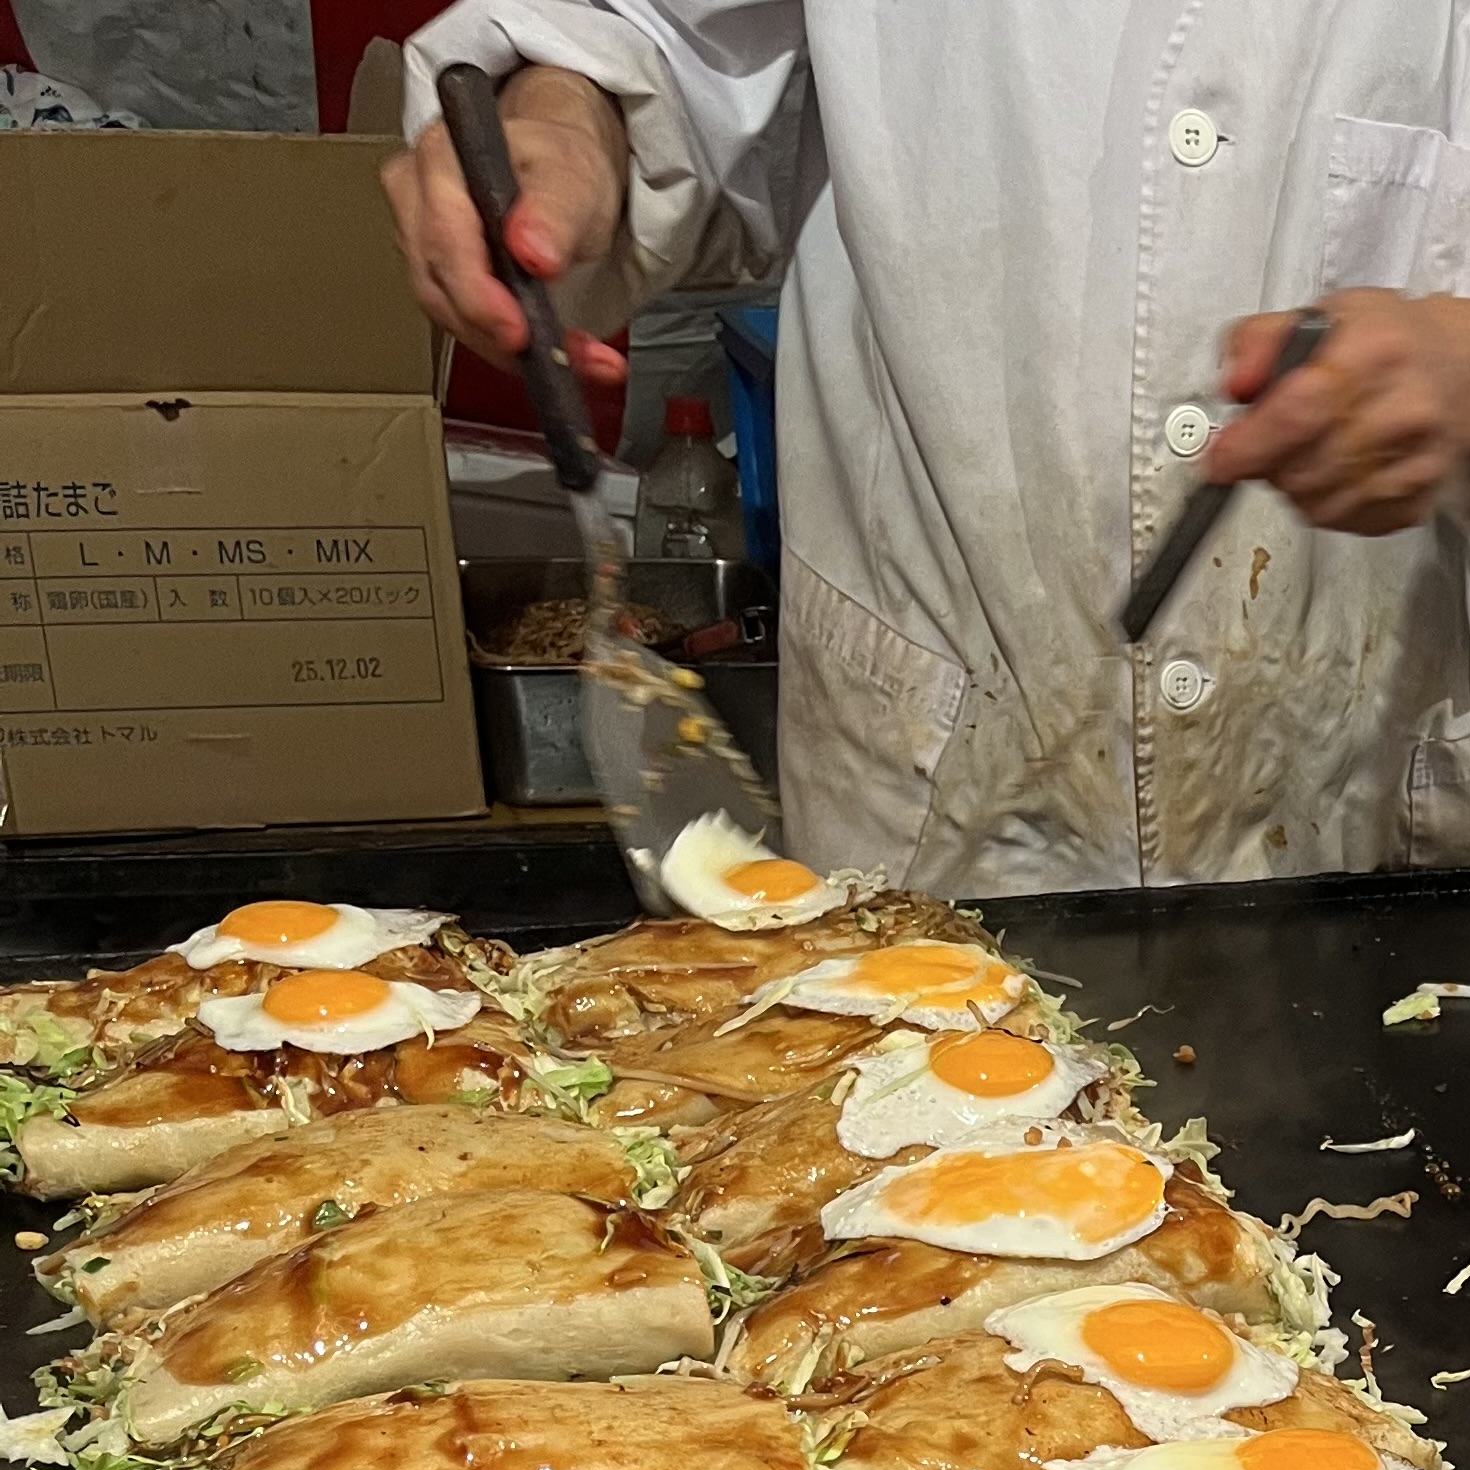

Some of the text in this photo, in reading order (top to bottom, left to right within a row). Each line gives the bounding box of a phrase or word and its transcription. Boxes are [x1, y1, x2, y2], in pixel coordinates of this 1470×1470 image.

[0, 480, 119, 520] 詰たまご
[80, 542, 99, 566] L
[144, 540, 171, 565] M
[218, 540, 267, 564] MS
[315, 539, 373, 563] MIX
[0, 663, 45, 683] 期限
[291, 657, 383, 682] 25.12.02
